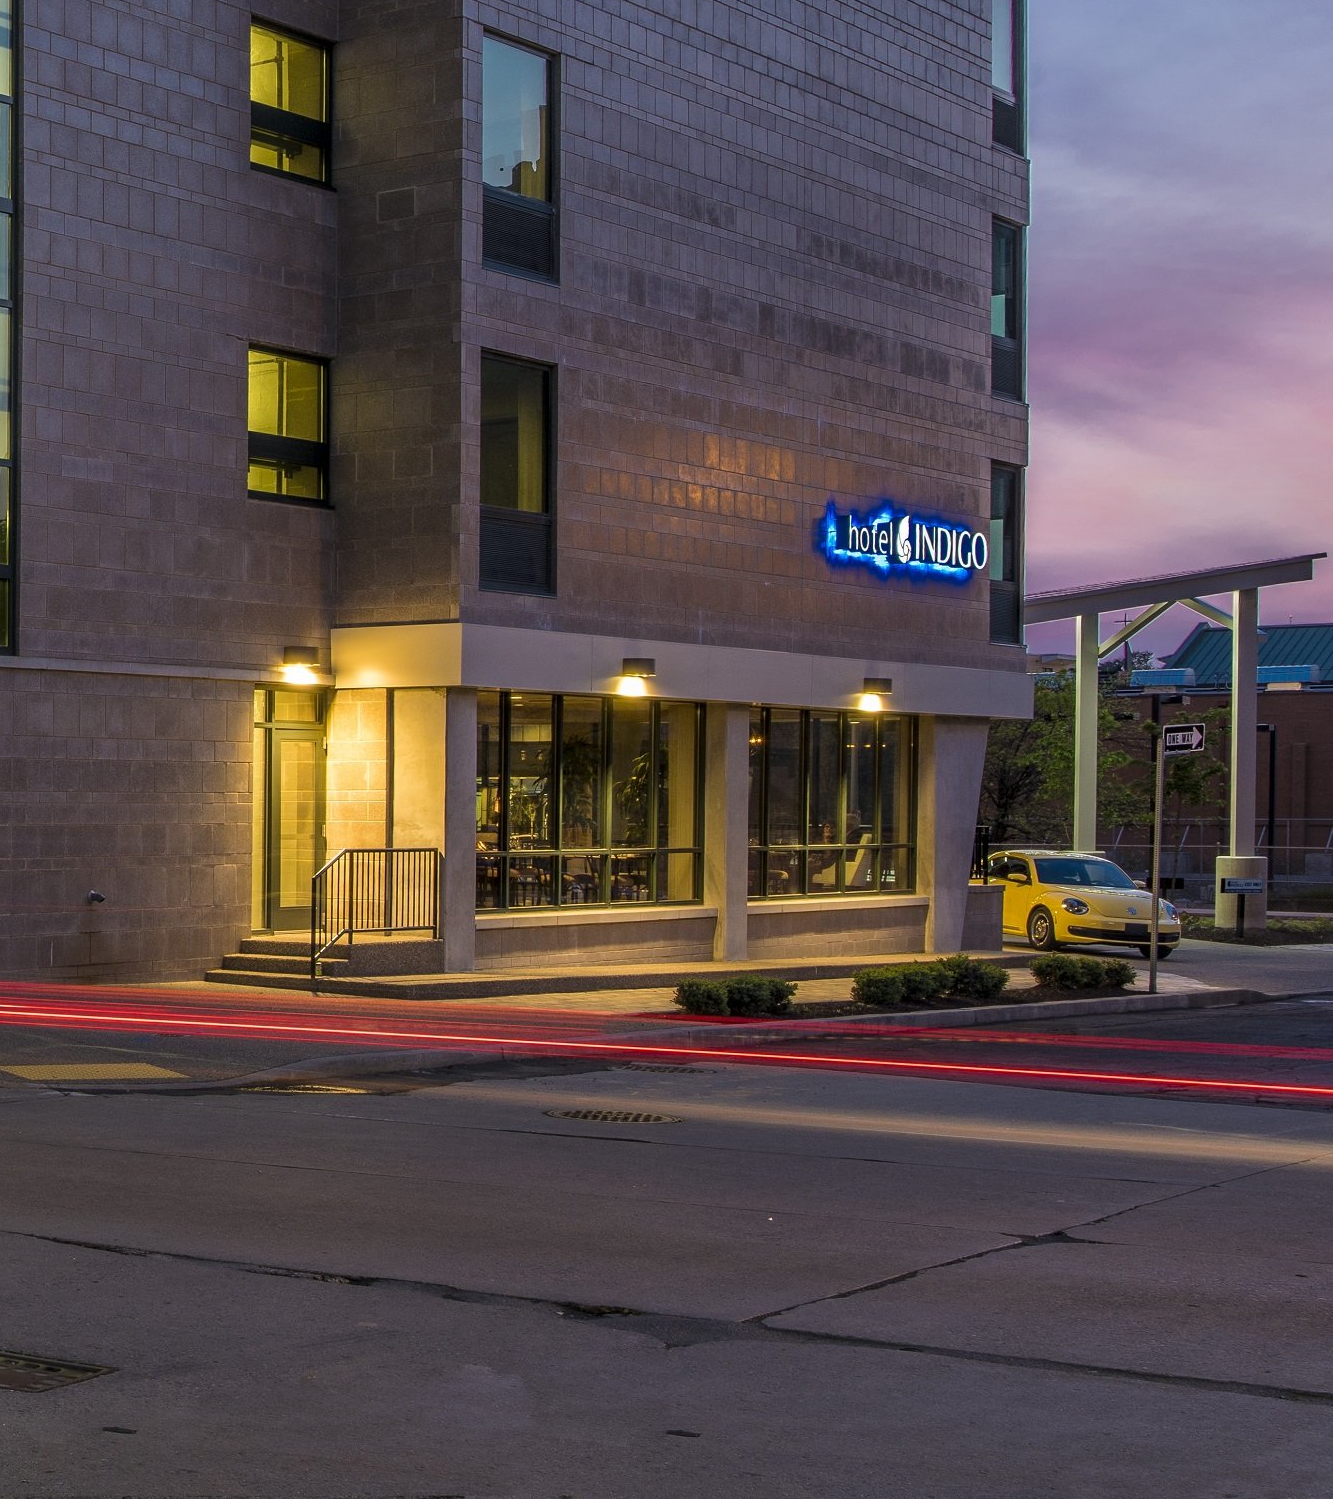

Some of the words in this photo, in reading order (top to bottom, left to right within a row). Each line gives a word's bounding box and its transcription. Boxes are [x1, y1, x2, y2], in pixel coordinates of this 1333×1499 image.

[849, 515, 893, 556] hotel
[915, 523, 988, 570] INDIGO
[1167, 733, 1179, 744] ONE
[1182, 732, 1194, 744] WAY
